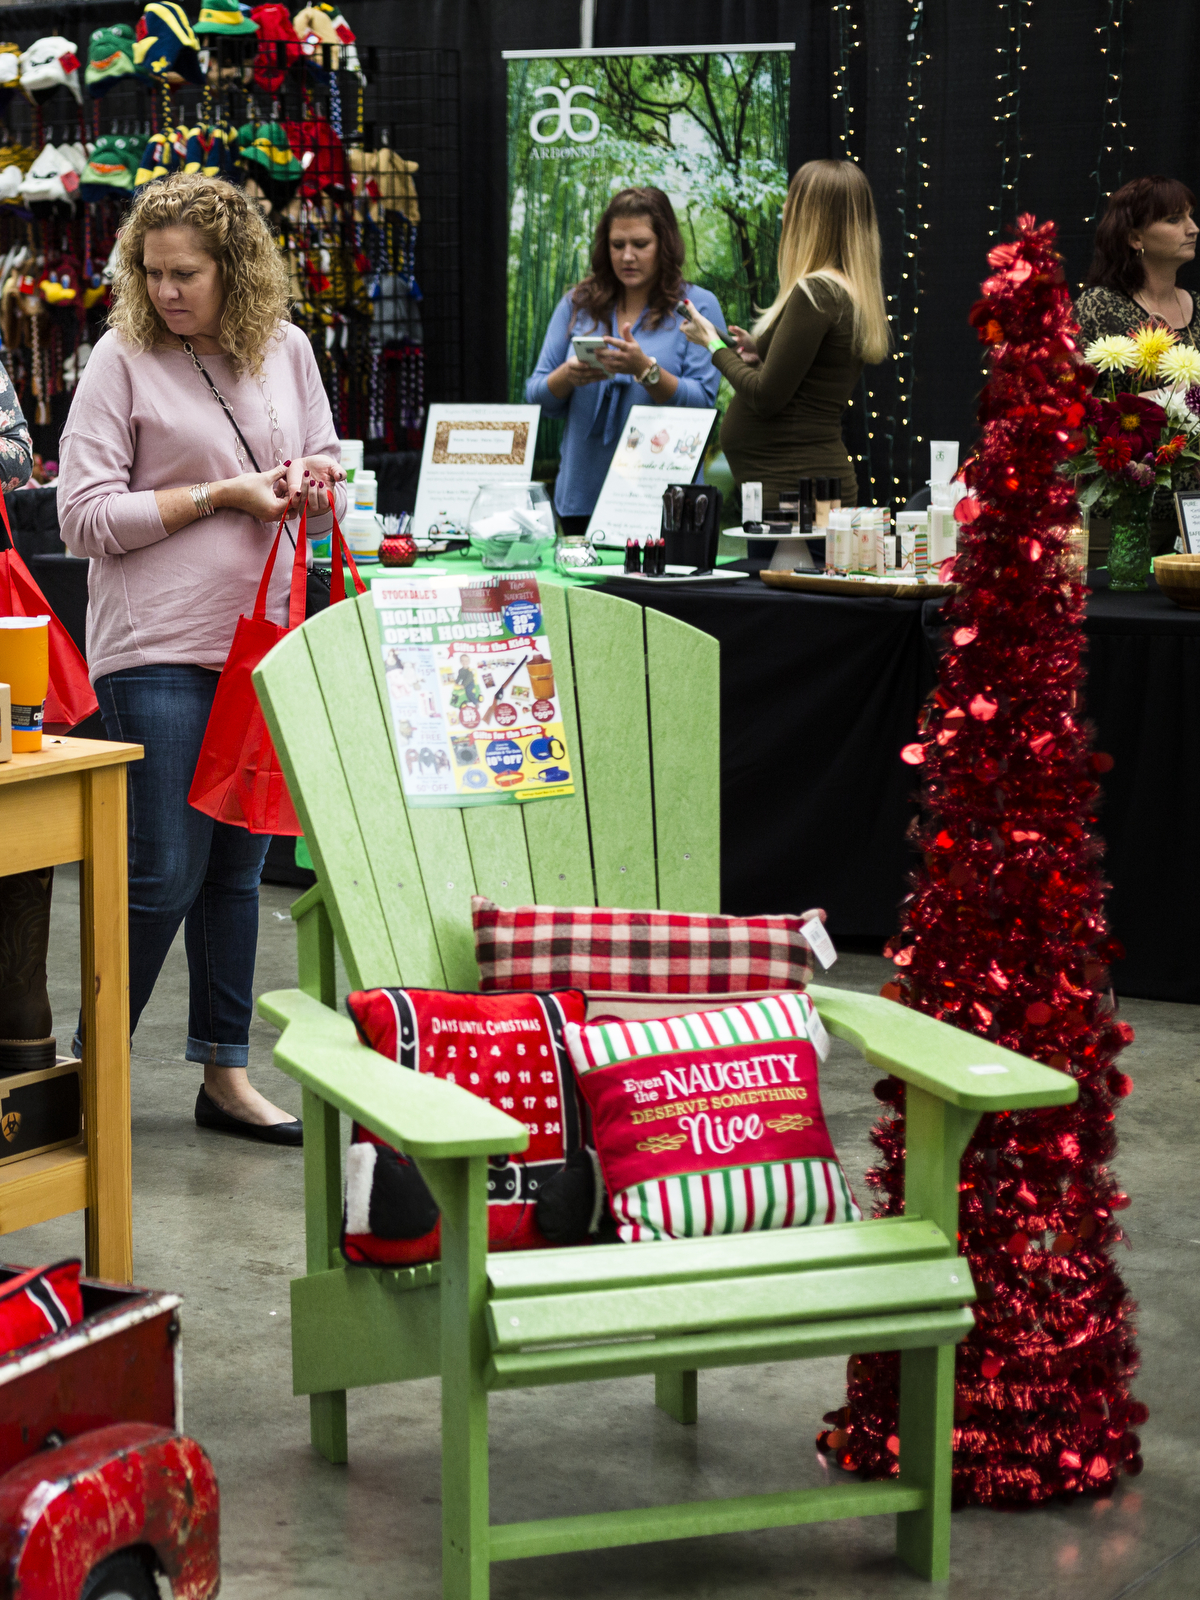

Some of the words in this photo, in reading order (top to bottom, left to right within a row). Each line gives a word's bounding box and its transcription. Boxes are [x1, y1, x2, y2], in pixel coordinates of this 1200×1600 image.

[530, 146, 600, 159] ARBONNE
[381, 589, 437, 600] STOCKDALE'S
[503, 591, 535, 601] NAUGHTY
[380, 606, 461, 627] HOLIDAY
[384, 627, 434, 644] OPEN
[437, 621, 504, 641] HOUSE
[513, 622, 536, 634] OFF
[453, 642, 476, 652] Gifts
[476, 644, 490, 652] for
[490, 642, 508, 652] the
[507, 637, 531, 650] Kids
[472, 731, 493, 740] Gifts
[493, 732, 506, 740] for
[506, 730, 521, 739] the
[520, 726, 542, 736] Dogs
[503, 754, 523, 765] OFF
[458, 1020, 486, 1035] UNTIL
[426, 1045, 435, 1058] 1
[447, 1045, 457, 1058] 2
[469, 1046, 478, 1058] 3
[490, 1044, 501, 1057] 4
[517, 1043, 526, 1056] 5
[540, 1045, 548, 1057] 6
[470, 1072, 480, 1085] 9
[494, 1070, 510, 1083] 10
[518, 1071, 531, 1083] 11
[540, 1071, 554, 1083] 12
[623, 1075, 663, 1093] Even
[660, 1053, 801, 1100] NAUGHTY
[500, 1096, 514, 1109] 16
[523, 1096, 537, 1109] 17
[545, 1096, 558, 1109] 18
[634, 1090, 659, 1104] the
[630, 1098, 709, 1125] DESERVE
[710, 1086, 808, 1109] SOMETHING
[544, 1122, 561, 1135] 24
[678, 1112, 764, 1155] Nice
